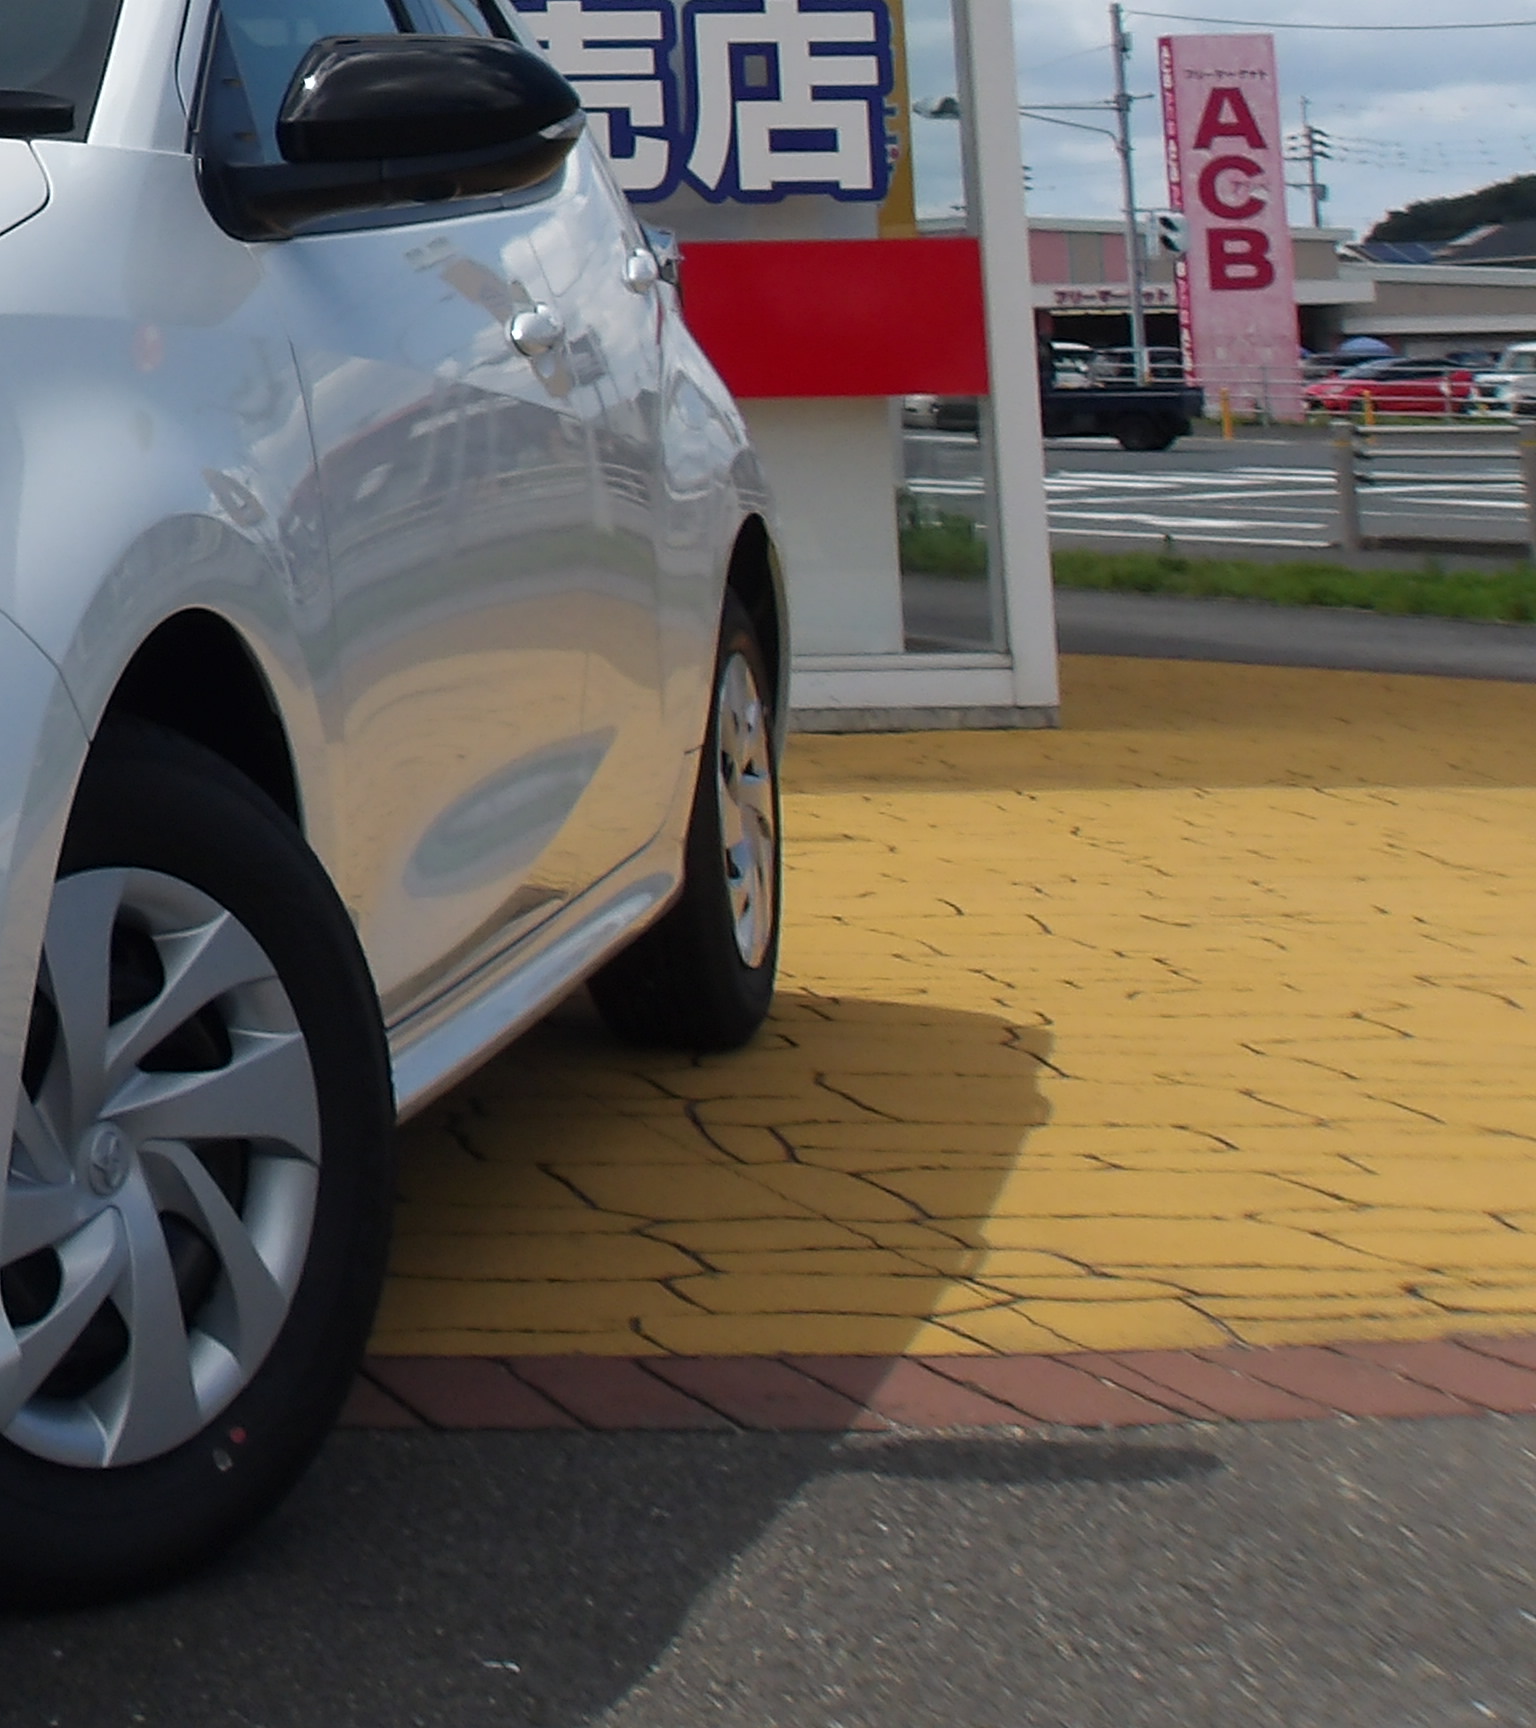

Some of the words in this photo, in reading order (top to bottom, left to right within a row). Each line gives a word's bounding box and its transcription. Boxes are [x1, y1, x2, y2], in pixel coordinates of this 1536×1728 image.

[1192, 87, 1275, 291] ACB
[1054, 288, 1169, 304] フリーマーット
